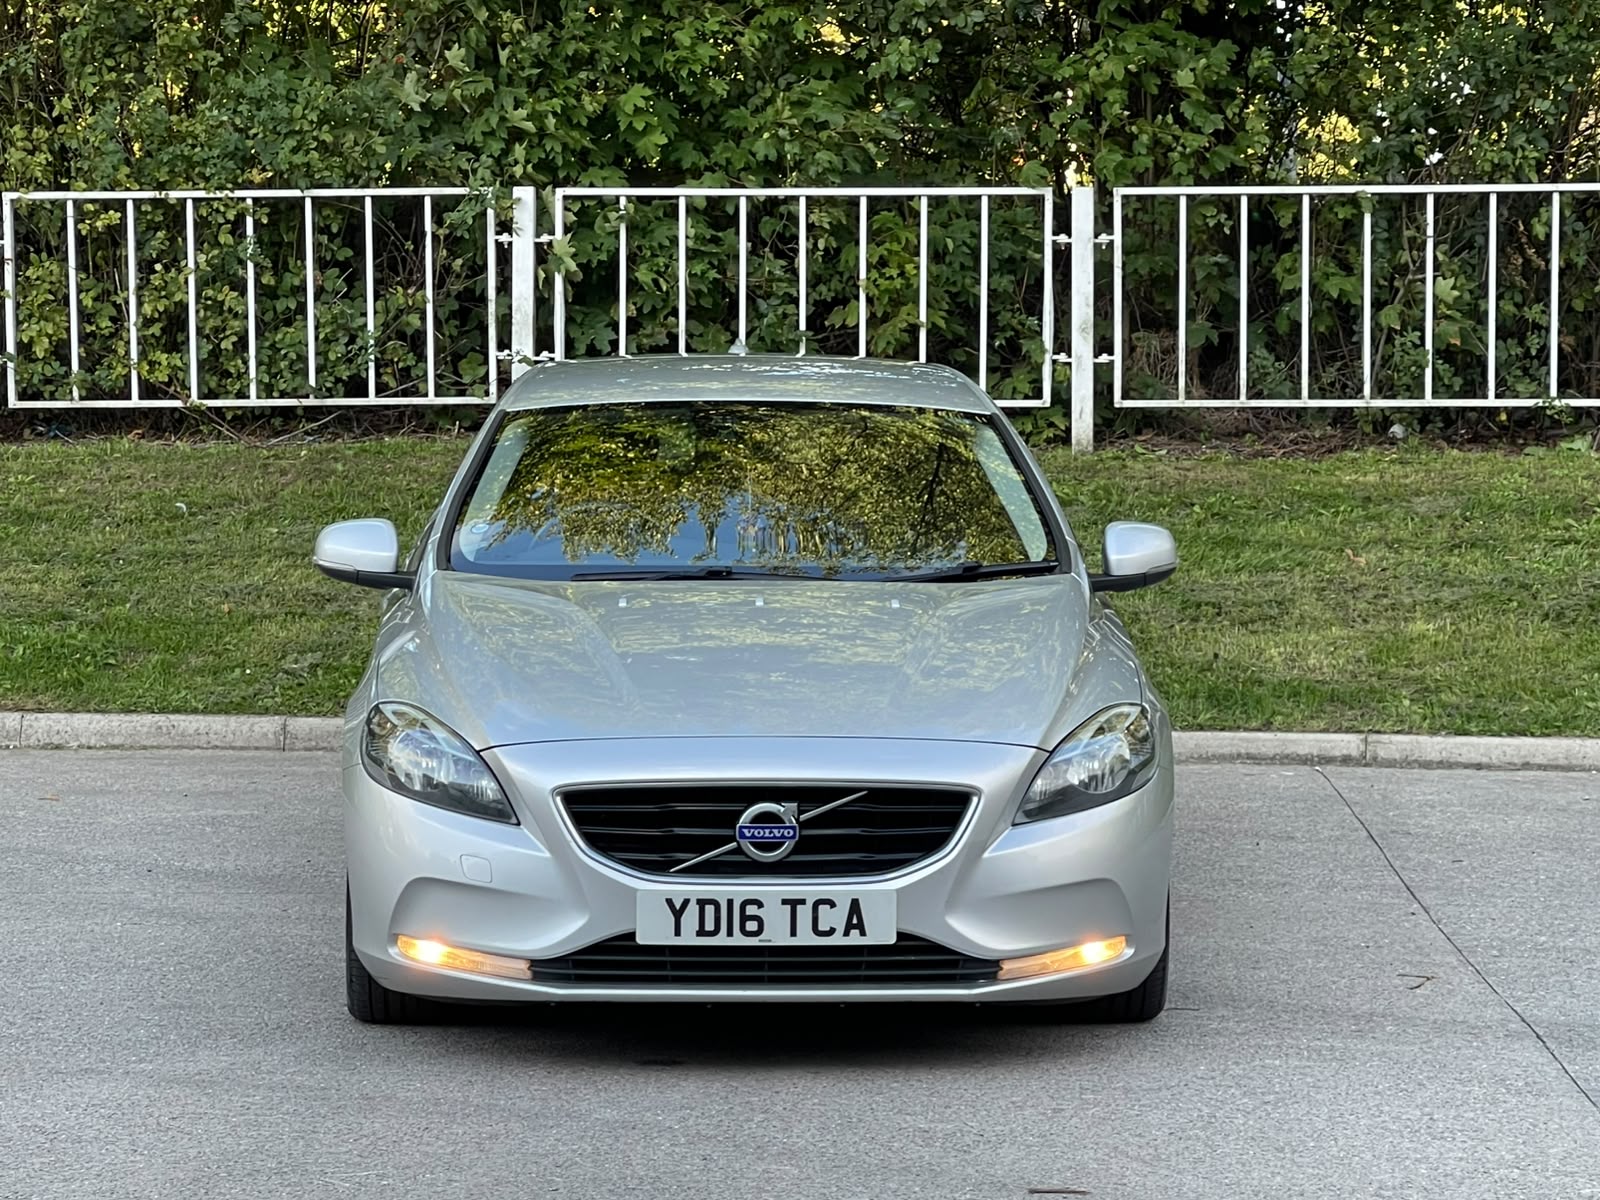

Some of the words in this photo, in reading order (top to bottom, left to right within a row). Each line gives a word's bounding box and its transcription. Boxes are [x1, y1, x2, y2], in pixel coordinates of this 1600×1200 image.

[741, 828, 794, 838] VOLVO
[664, 898, 765, 938] YD16
[781, 898, 868, 938] TCA
